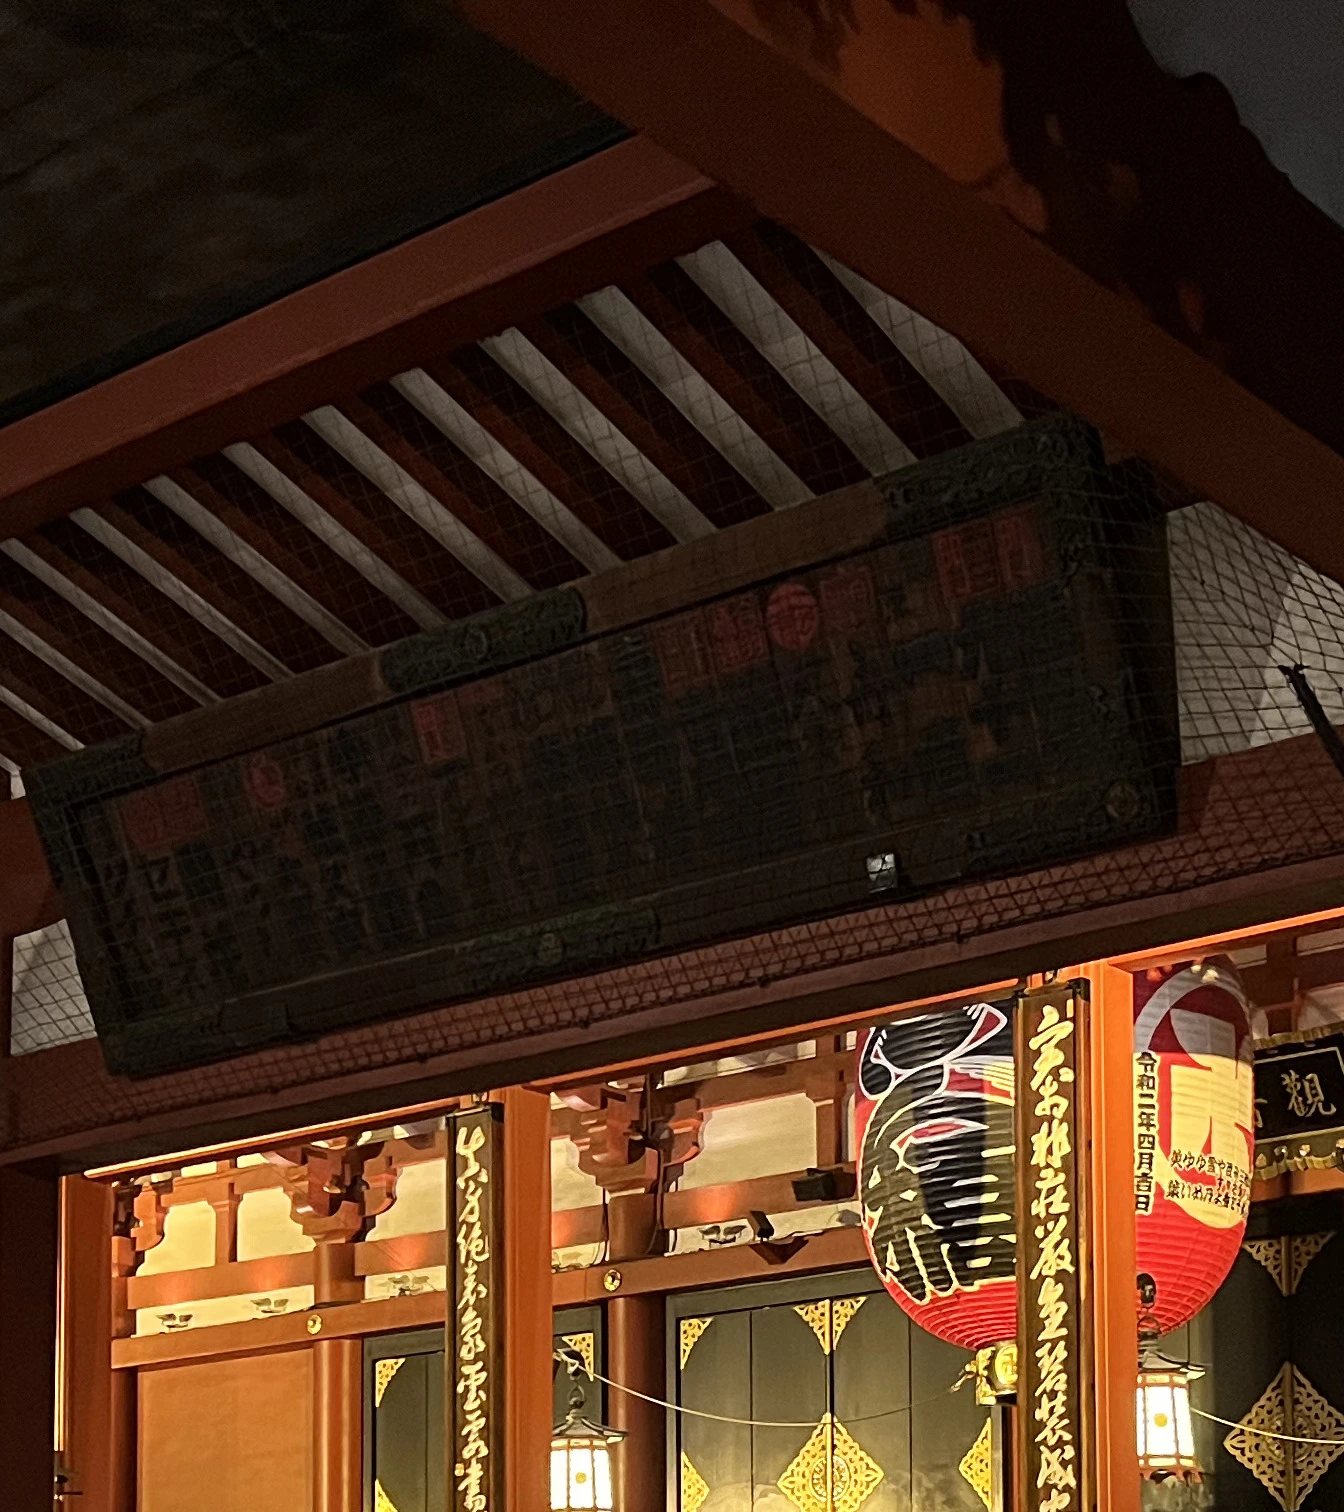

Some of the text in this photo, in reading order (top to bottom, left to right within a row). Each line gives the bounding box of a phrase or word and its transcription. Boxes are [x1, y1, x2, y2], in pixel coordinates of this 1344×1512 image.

[1135, 1052, 1157, 1212] 令和二年四月吉日
